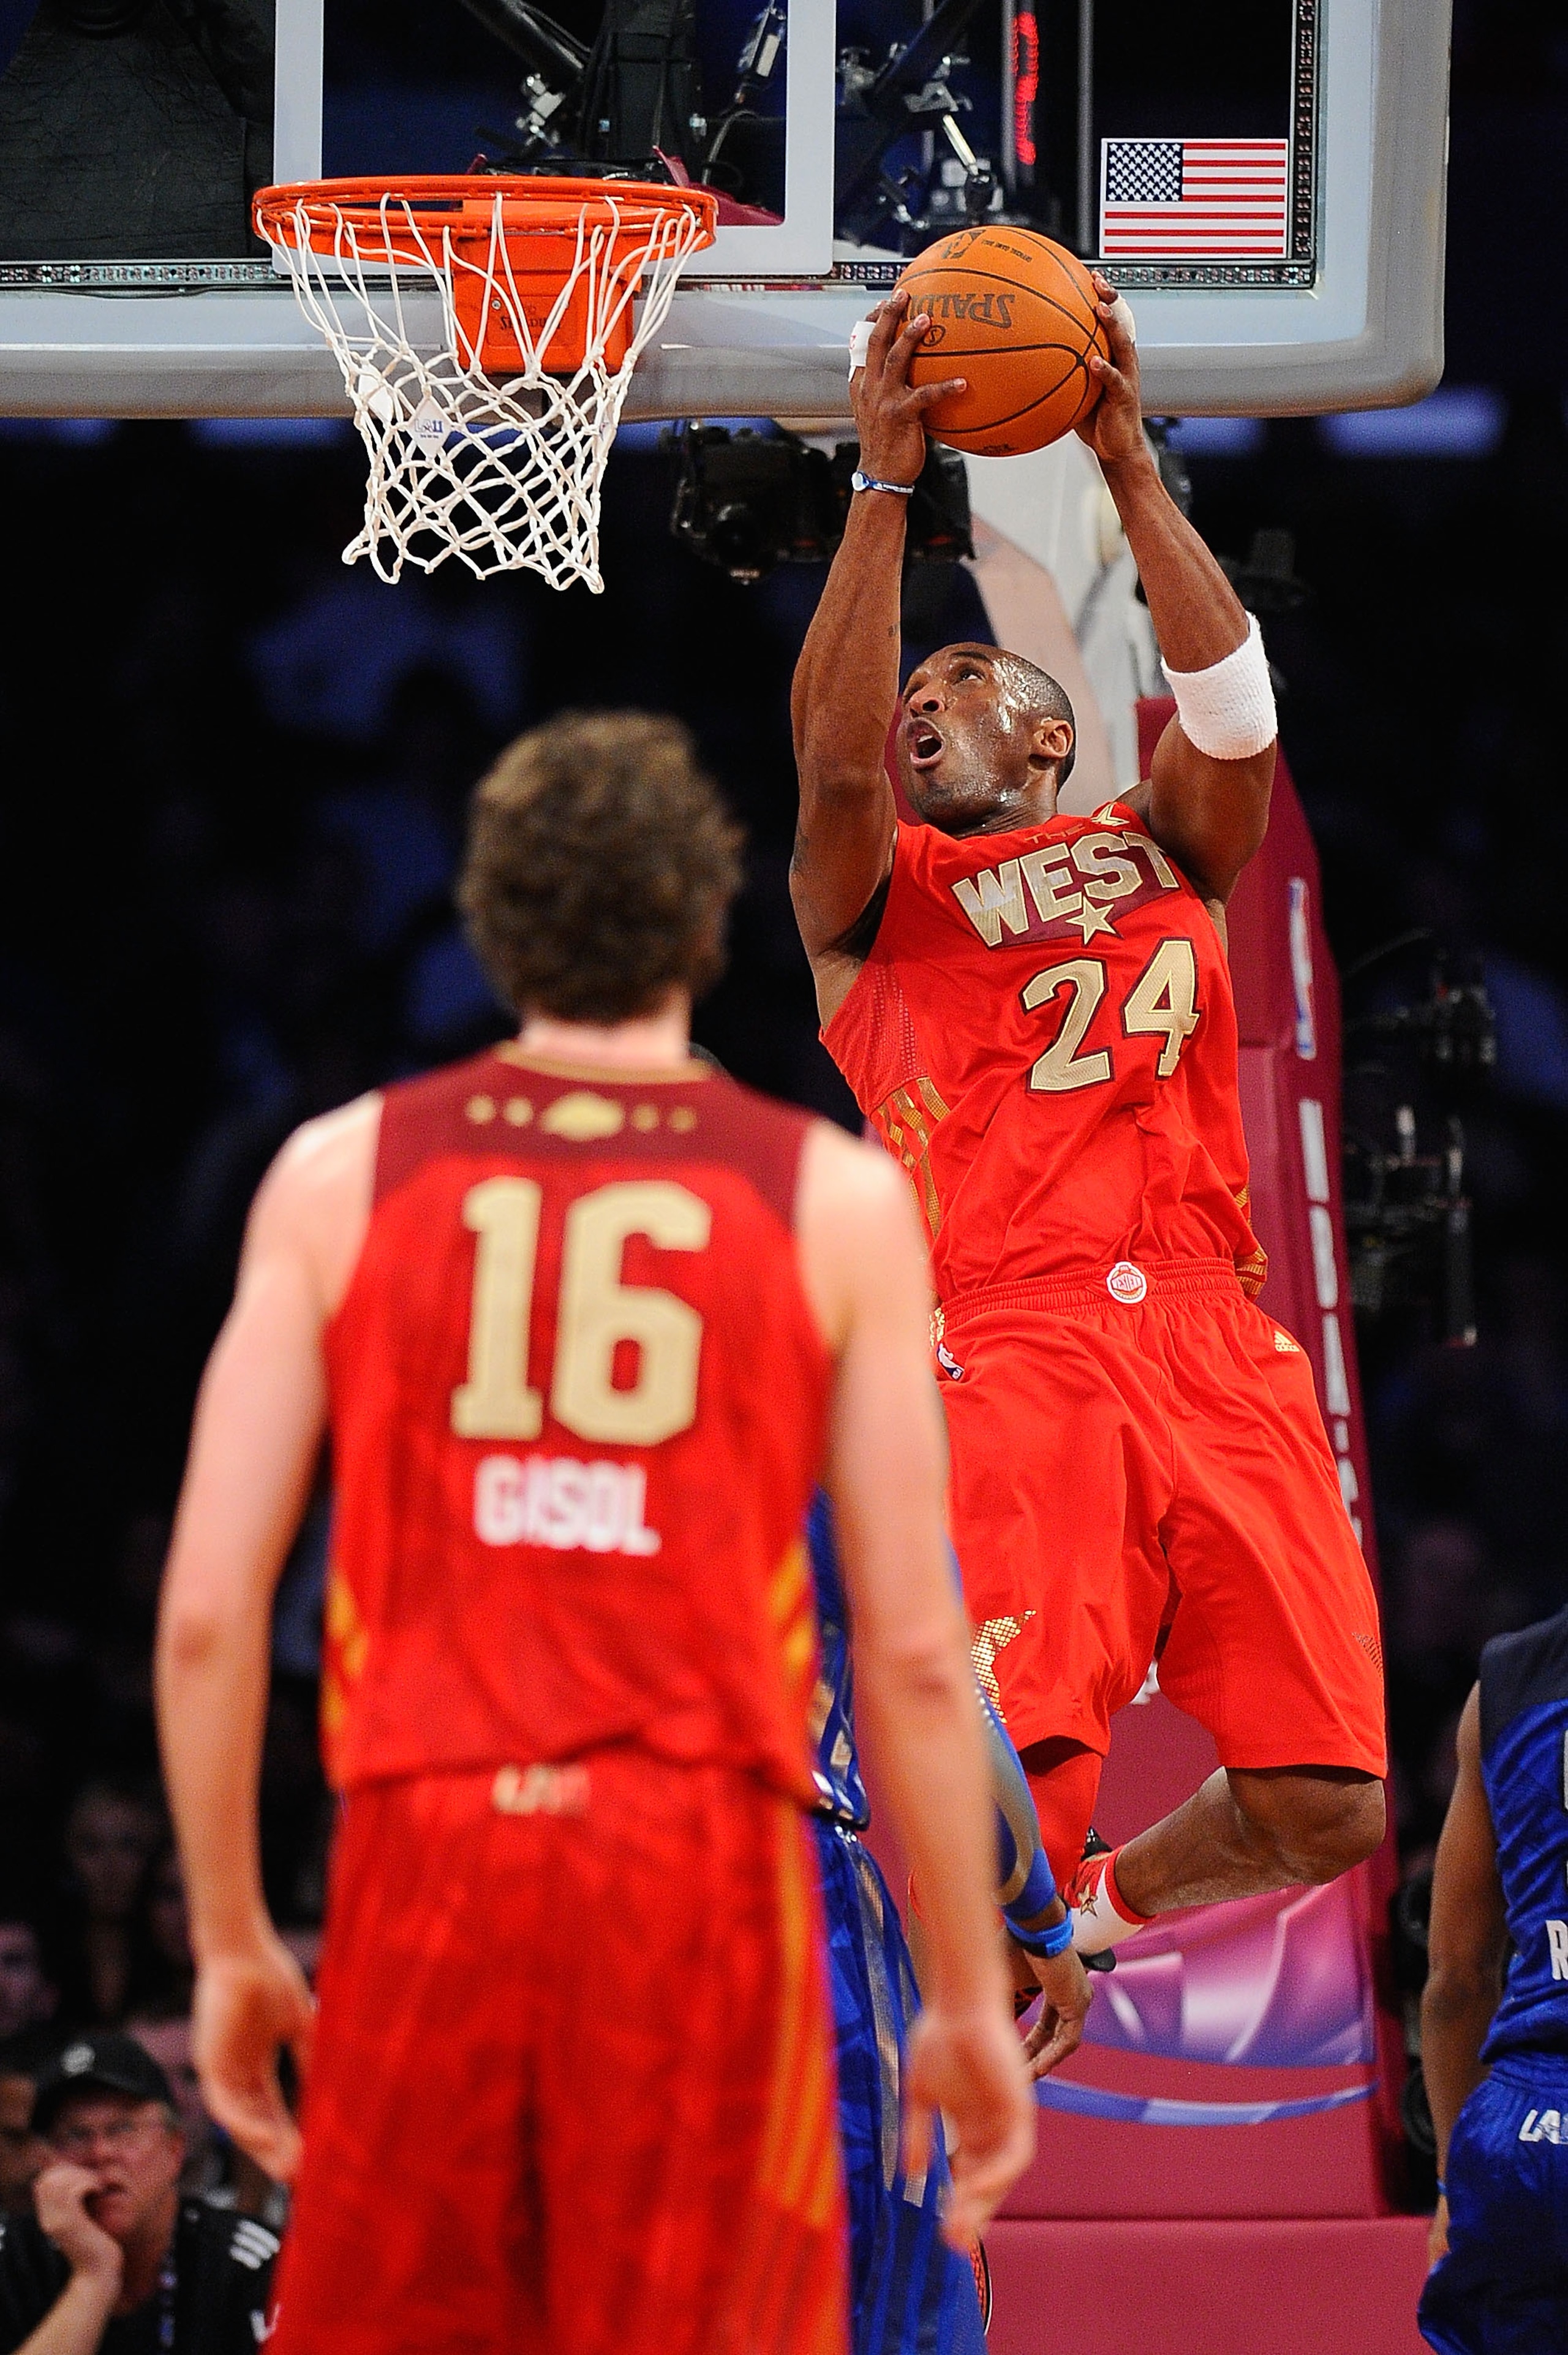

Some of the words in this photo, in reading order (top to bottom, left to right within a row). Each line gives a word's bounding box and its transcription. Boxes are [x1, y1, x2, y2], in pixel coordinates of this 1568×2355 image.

[905, 294, 1016, 328] SPALDI
[951, 831, 1180, 948] WEST
[1024, 823, 1085, 844] THE
[1019, 938, 1200, 1094] 24
[450, 1174, 712, 1447] 16
